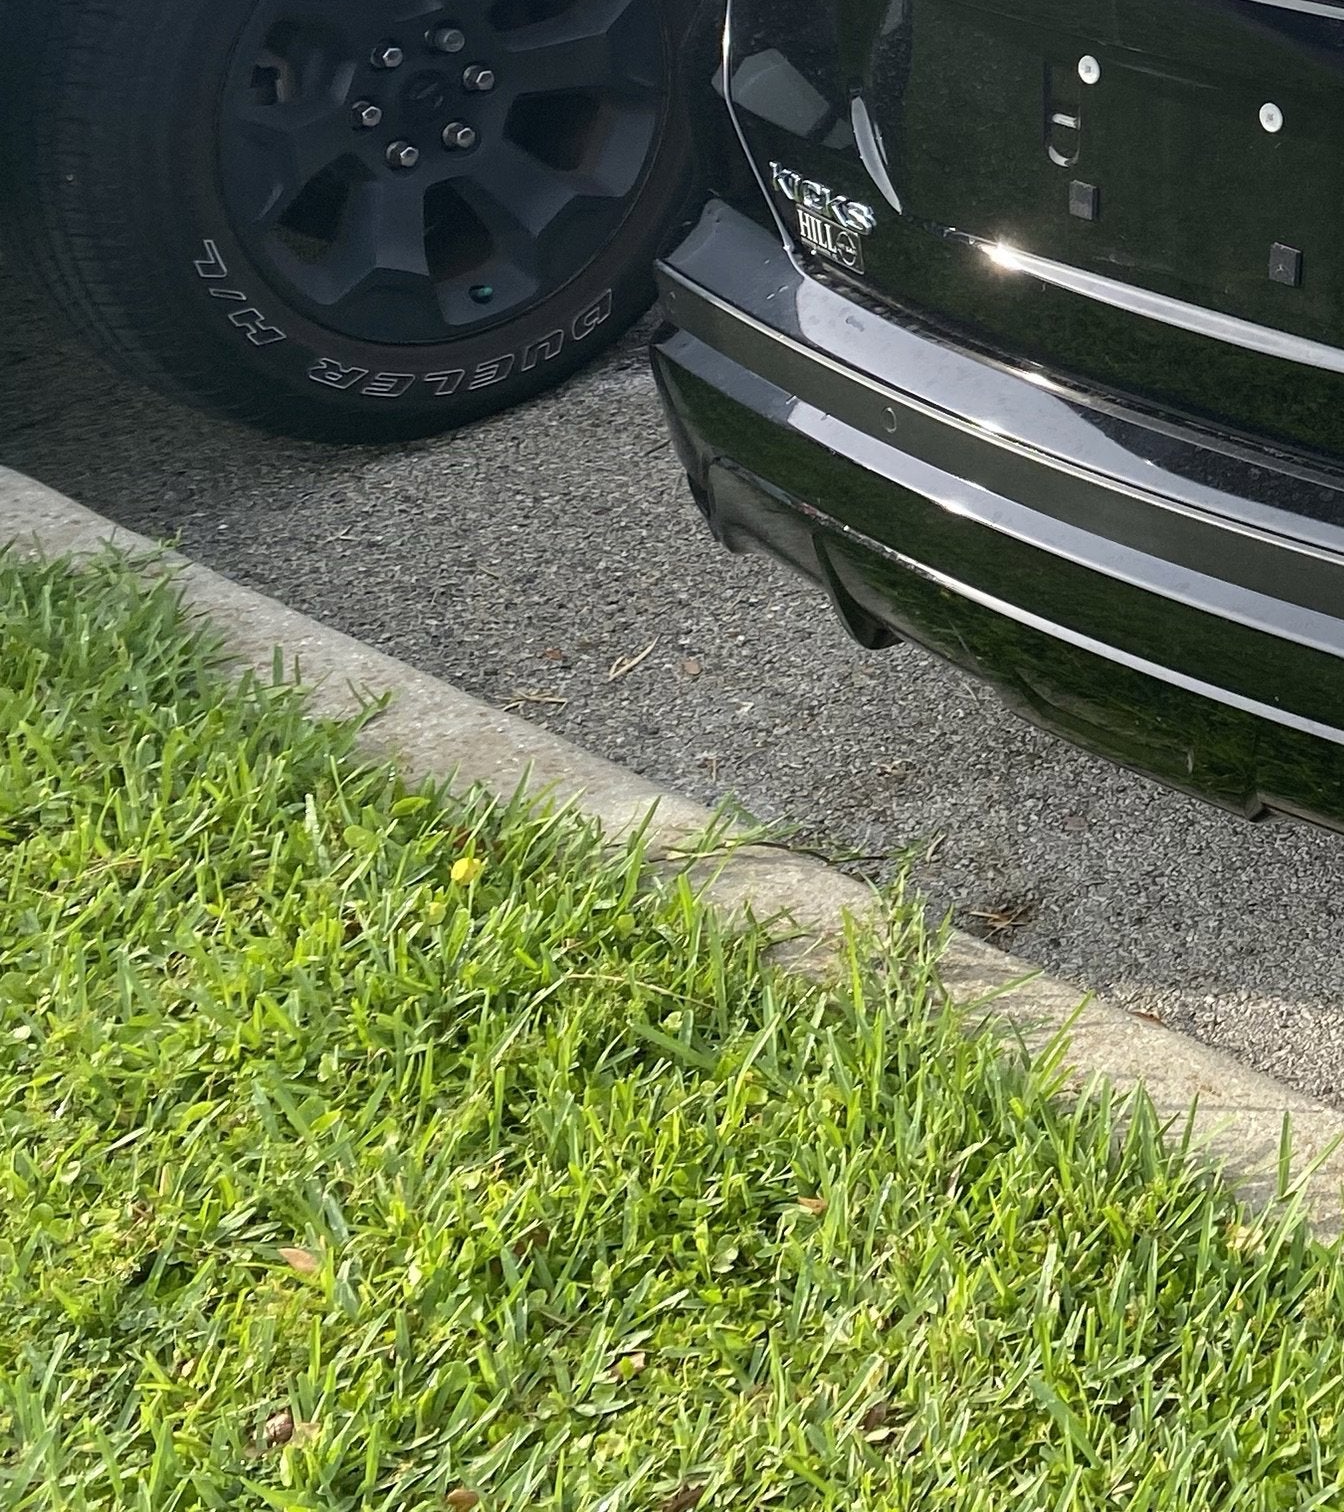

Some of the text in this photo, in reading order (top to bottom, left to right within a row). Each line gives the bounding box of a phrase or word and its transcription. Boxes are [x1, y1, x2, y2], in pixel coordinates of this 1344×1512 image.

[769, 160, 878, 236] KICKS
[796, 209, 838, 254] HILL
[307, 288, 613, 398] DUELER
